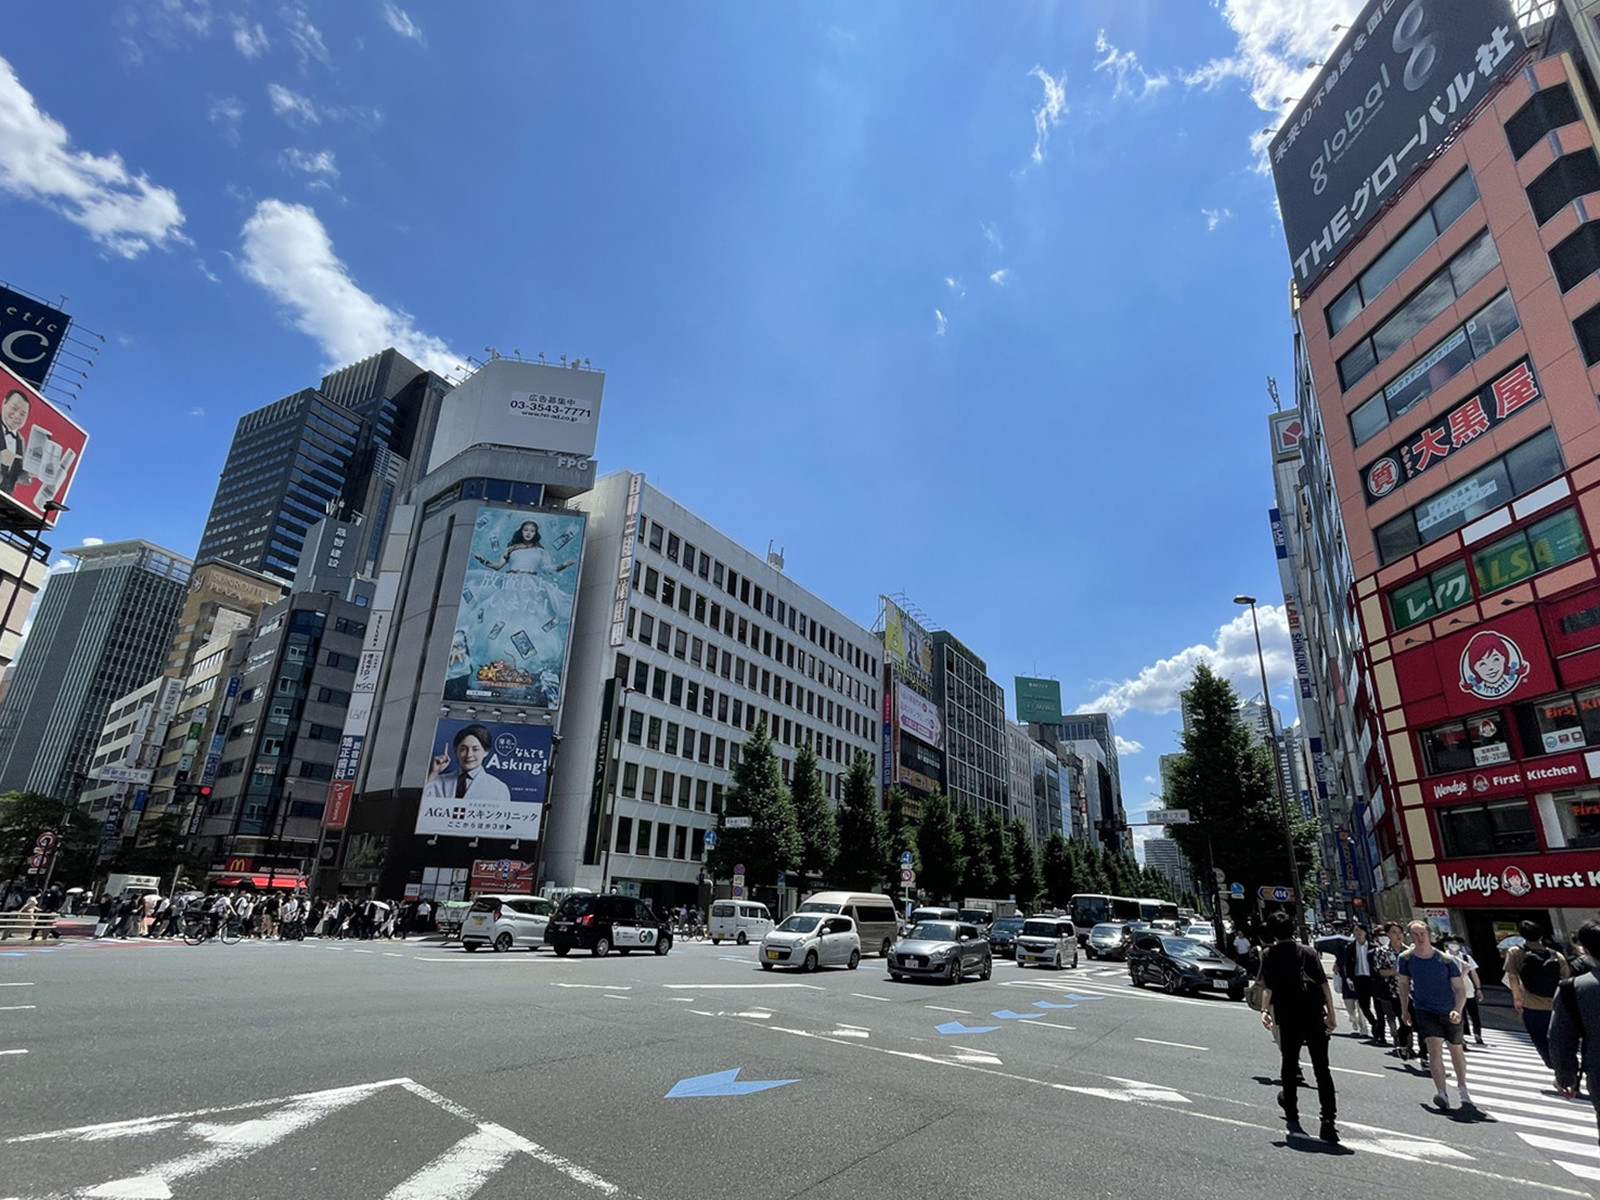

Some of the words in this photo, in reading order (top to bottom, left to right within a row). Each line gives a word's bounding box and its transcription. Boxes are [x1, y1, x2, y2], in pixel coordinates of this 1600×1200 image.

[1309, 63, 1391, 195] global
[1293, 25, 1514, 279] THEグローバル社
[510, 400, 591, 417] 03-3543-7771
[1412, 361, 1539, 472] 大黒屋
[557, 457, 589, 471] FPG
[1371, 460, 1395, 494] 質
[1406, 574, 1466, 621] レイク
[1292, 633, 1308, 675] SHINJUKU
[515, 747, 545, 759] なんでも
[597, 721, 608, 773] PRESTIA
[485, 753, 548, 776] Asking!
[1433, 780, 1468, 799] Wendy's
[1492, 774, 1521, 786] First
[1526, 765, 1578, 781] Kitchen
[424, 807, 451, 818] AGA
[467, 809, 538, 822] スキンクリニック
[1274, 890, 1287, 899] 414
[1442, 868, 1499, 897] Wendy's
[1533, 871, 1584, 889] First
